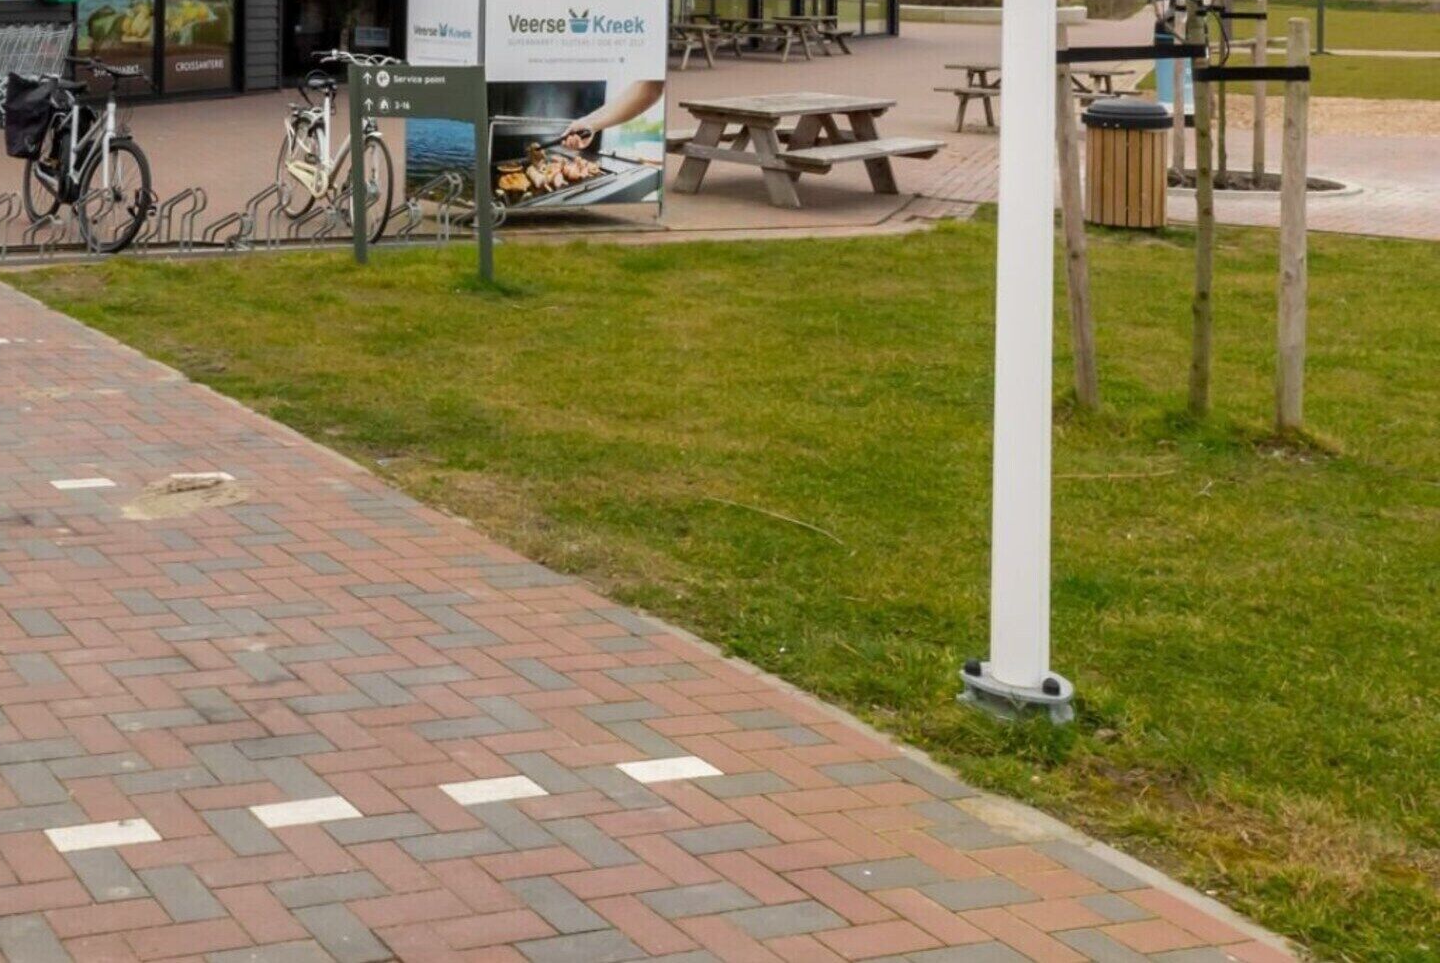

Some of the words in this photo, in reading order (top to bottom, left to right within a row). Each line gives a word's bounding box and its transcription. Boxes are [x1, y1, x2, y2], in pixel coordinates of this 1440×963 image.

[413, 23, 438, 37] Veerse
[507, 14, 566, 34] Veerse
[592, 15, 646, 35] Kreek
[393, 74, 423, 84] Service
[424, 75, 446, 85] point
